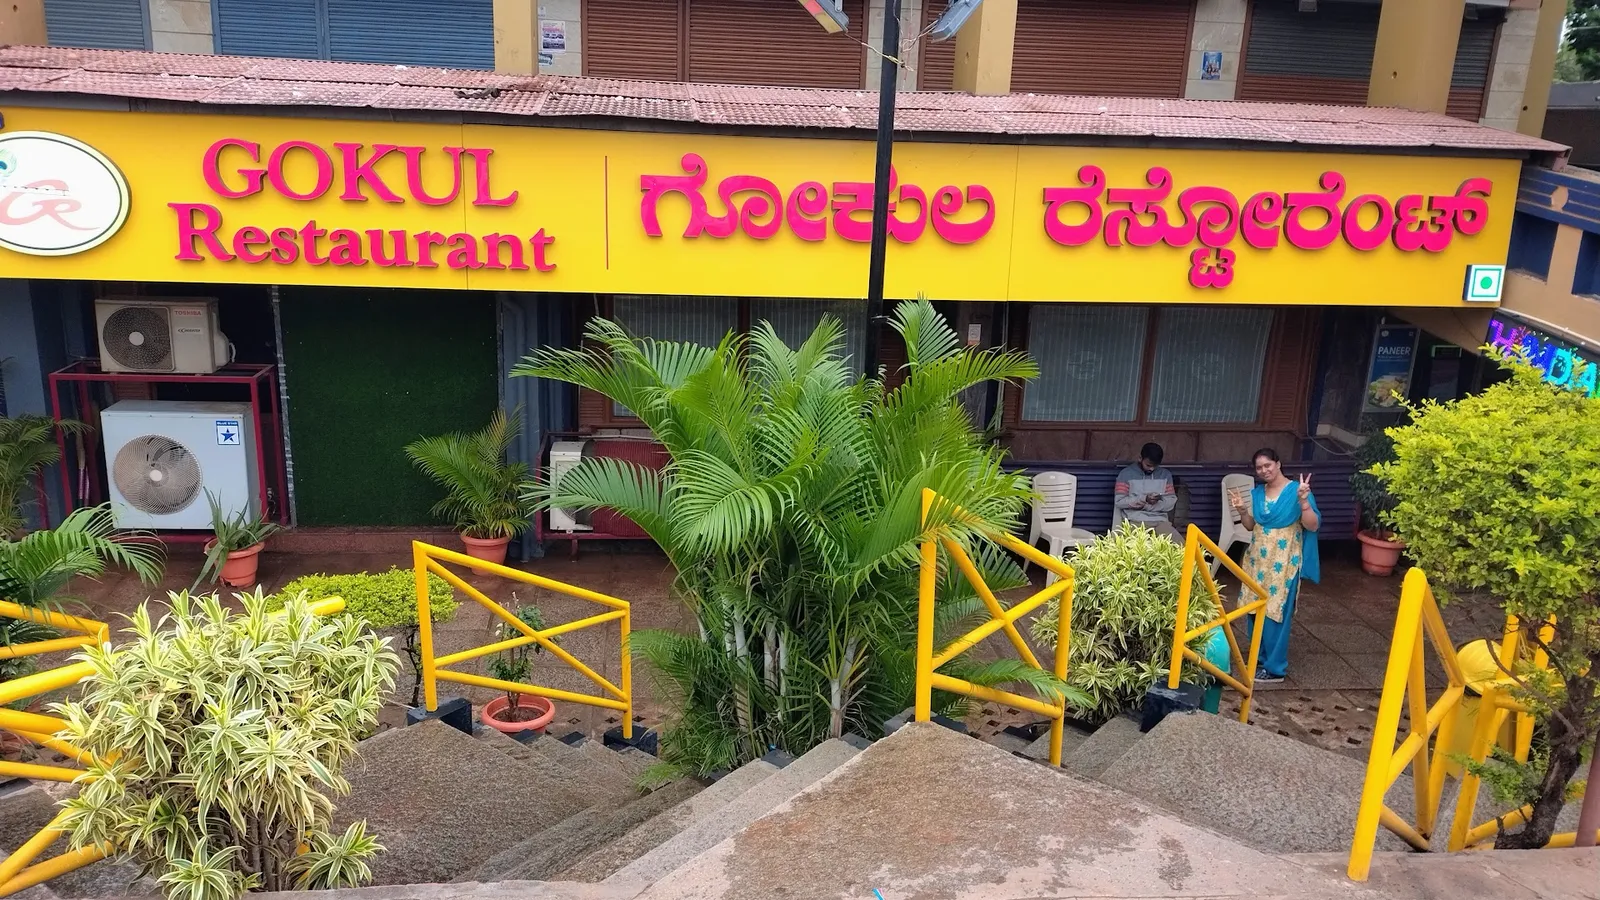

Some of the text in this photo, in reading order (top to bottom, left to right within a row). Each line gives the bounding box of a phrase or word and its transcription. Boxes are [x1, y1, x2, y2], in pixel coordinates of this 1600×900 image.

[203, 138, 518, 208] GOKUL
[168, 203, 556, 272] Restaurant
[640, 152, 1493, 288] ಗೋಕುಲ ರೆಸ್ಟೋರೆಂಟ್
[1377, 346, 1411, 355] PANEER
